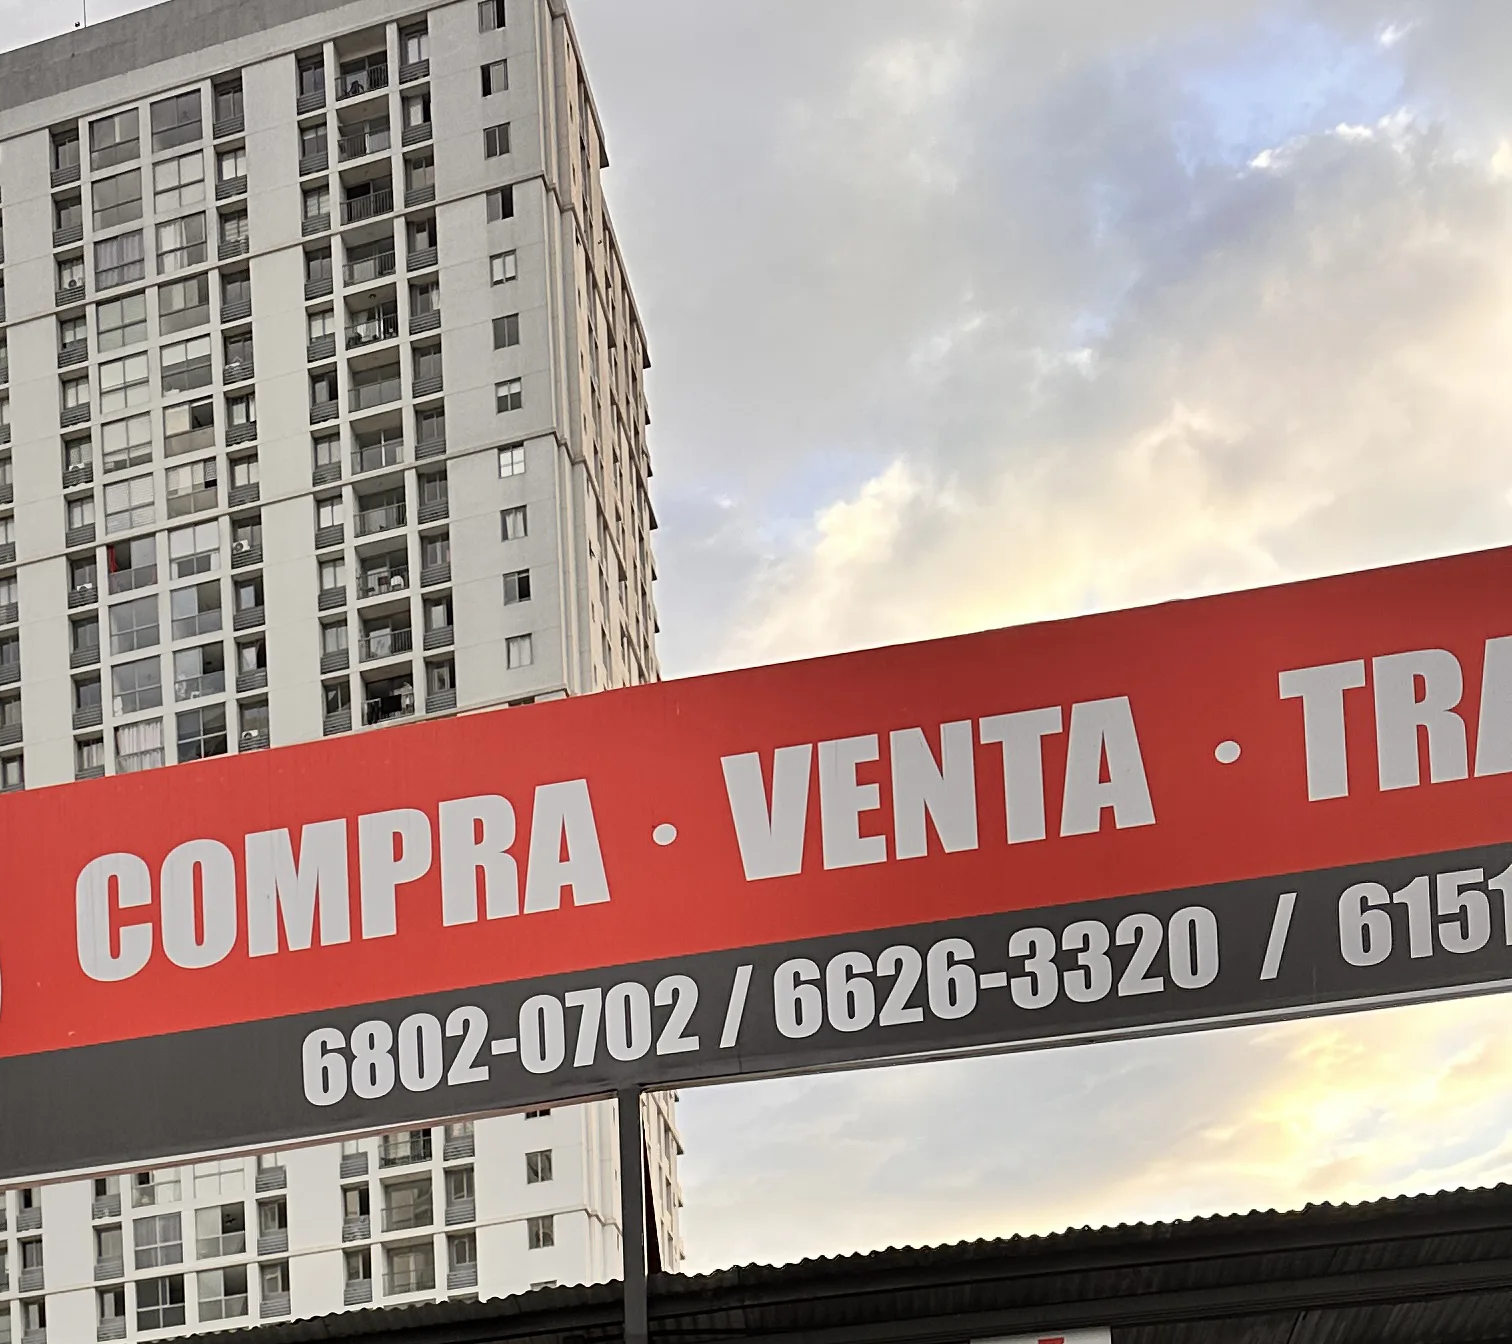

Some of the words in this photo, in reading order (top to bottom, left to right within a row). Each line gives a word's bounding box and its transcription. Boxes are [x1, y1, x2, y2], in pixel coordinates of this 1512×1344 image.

[74, 778, 611, 983] COMPRA
[719, 695, 1156, 882] VENTA
[301, 974, 701, 1107] 6802-0702
[772, 905, 1220, 1041] 6626-3320
